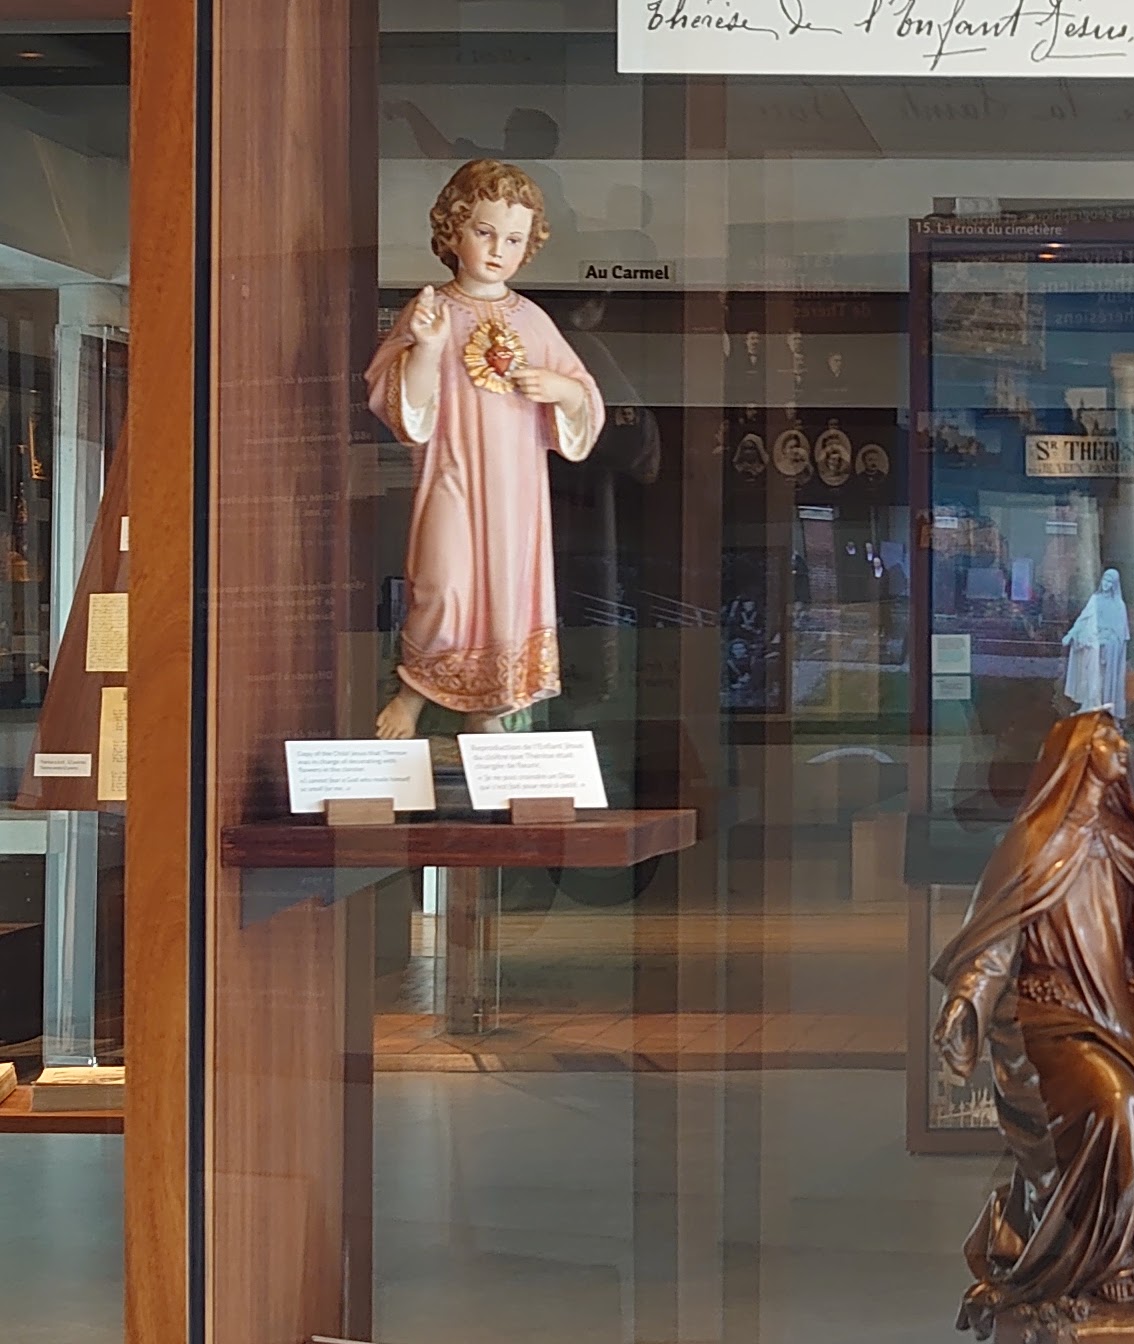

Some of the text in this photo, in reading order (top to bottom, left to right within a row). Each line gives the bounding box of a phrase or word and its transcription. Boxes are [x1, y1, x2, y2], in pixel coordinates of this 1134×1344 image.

[916, 222, 1062, 235] 15. La croix du cimetière
[585, 265, 669, 279] Au Carmel
